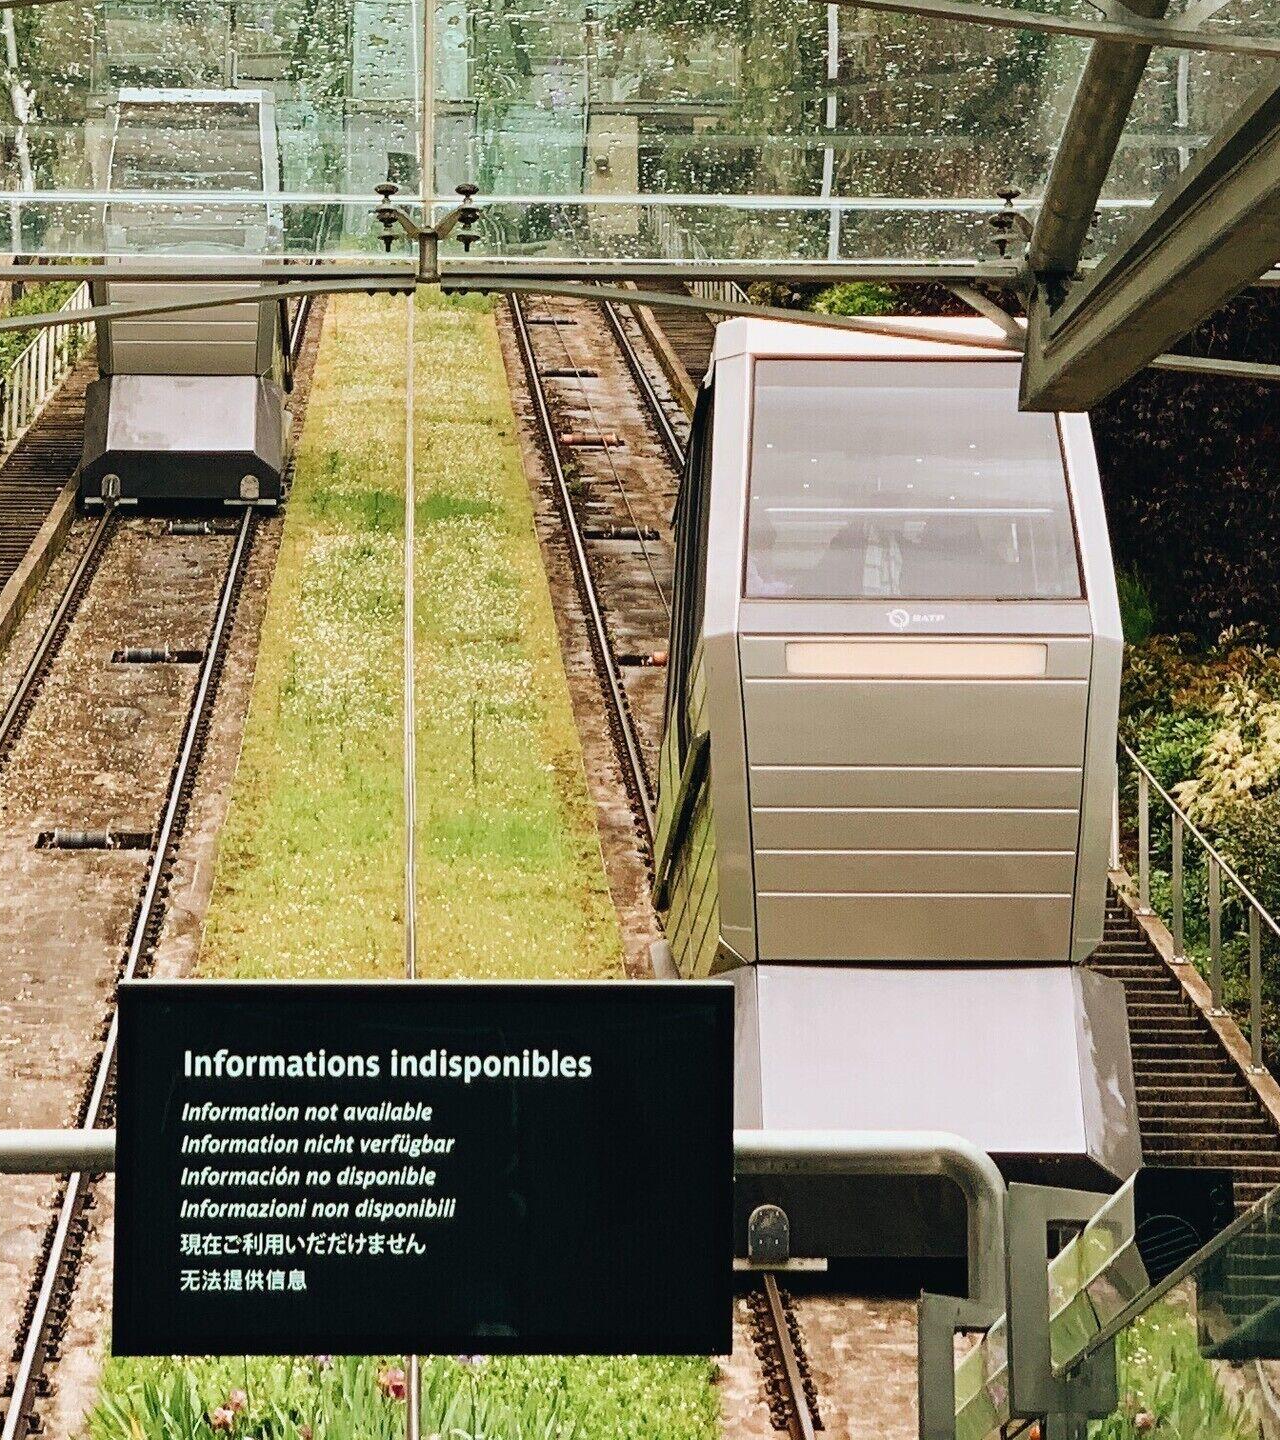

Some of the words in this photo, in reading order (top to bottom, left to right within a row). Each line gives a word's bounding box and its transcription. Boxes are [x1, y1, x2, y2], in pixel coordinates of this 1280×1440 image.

[184, 1048, 380, 1078] Informations
[390, 1048, 593, 1083] indisponibles
[182, 1101, 299, 1122] Information
[305, 1103, 339, 1122] not
[343, 1100, 433, 1122] available
[181, 1133, 298, 1155] Information
[304, 1132, 355, 1154] nicht
[359, 1132, 456, 1158] verfügbar
[180, 1165, 301, 1187] Información
[305, 1170, 332, 1187] no
[336, 1165, 437, 1190] disponible
[179, 1197, 308, 1220] Informazioni
[312, 1202, 350, 1220] non
[354, 1197, 457, 1223] disponibili
[179, 1268, 308, 1292] 无法提供信息
